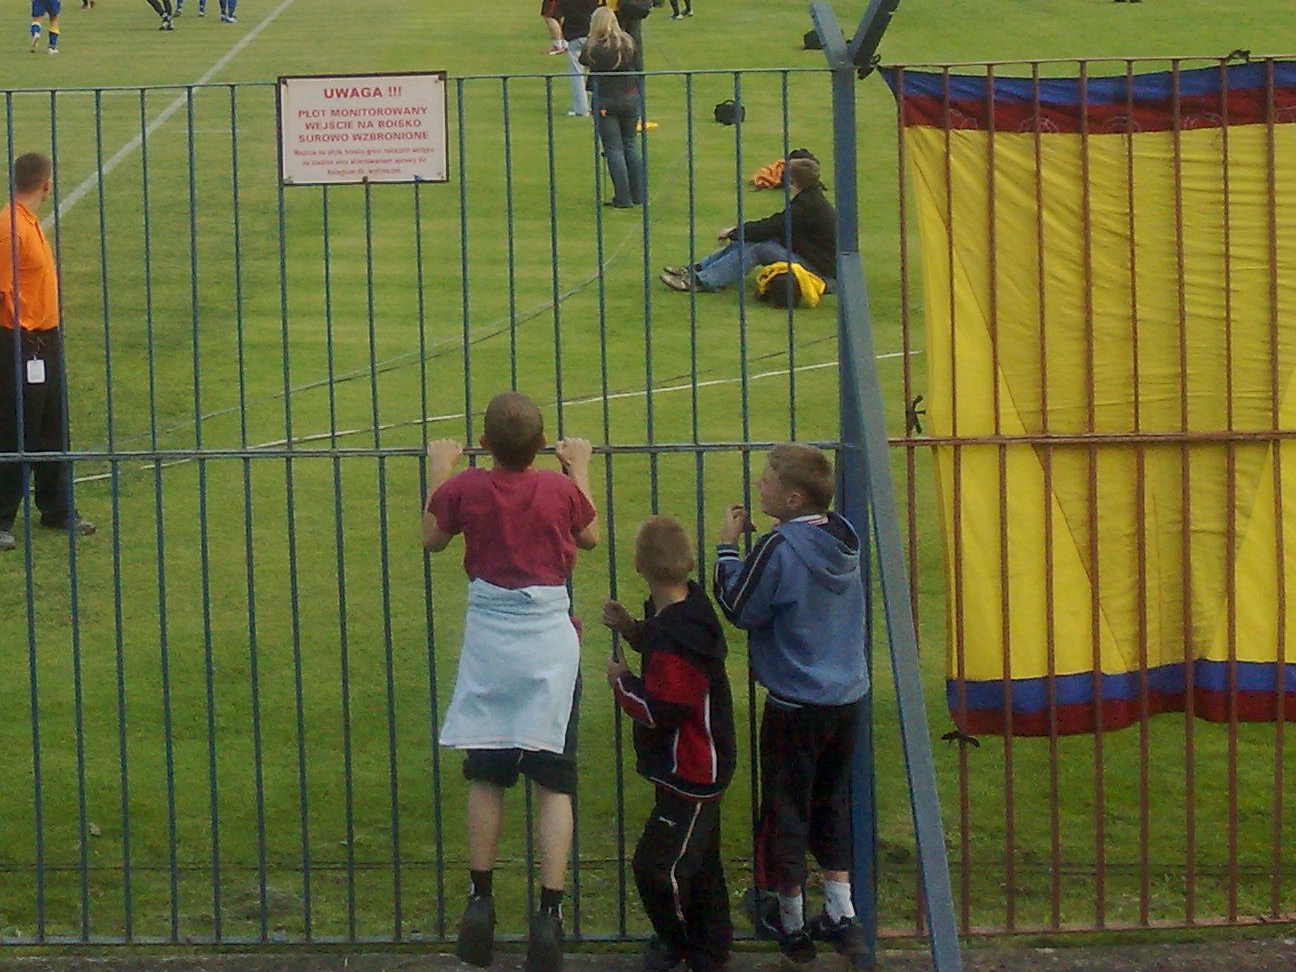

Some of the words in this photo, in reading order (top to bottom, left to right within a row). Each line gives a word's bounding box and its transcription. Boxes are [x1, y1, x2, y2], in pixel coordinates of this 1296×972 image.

[323, 86, 383, 99] UWAGA
[330, 106, 428, 118] MONITOROWANY
[357, 120, 374, 129] NA
[378, 119, 422, 129] BOISKO
[298, 133, 349, 143] SUROWO
[352, 131, 429, 141] WZBRONIONE
